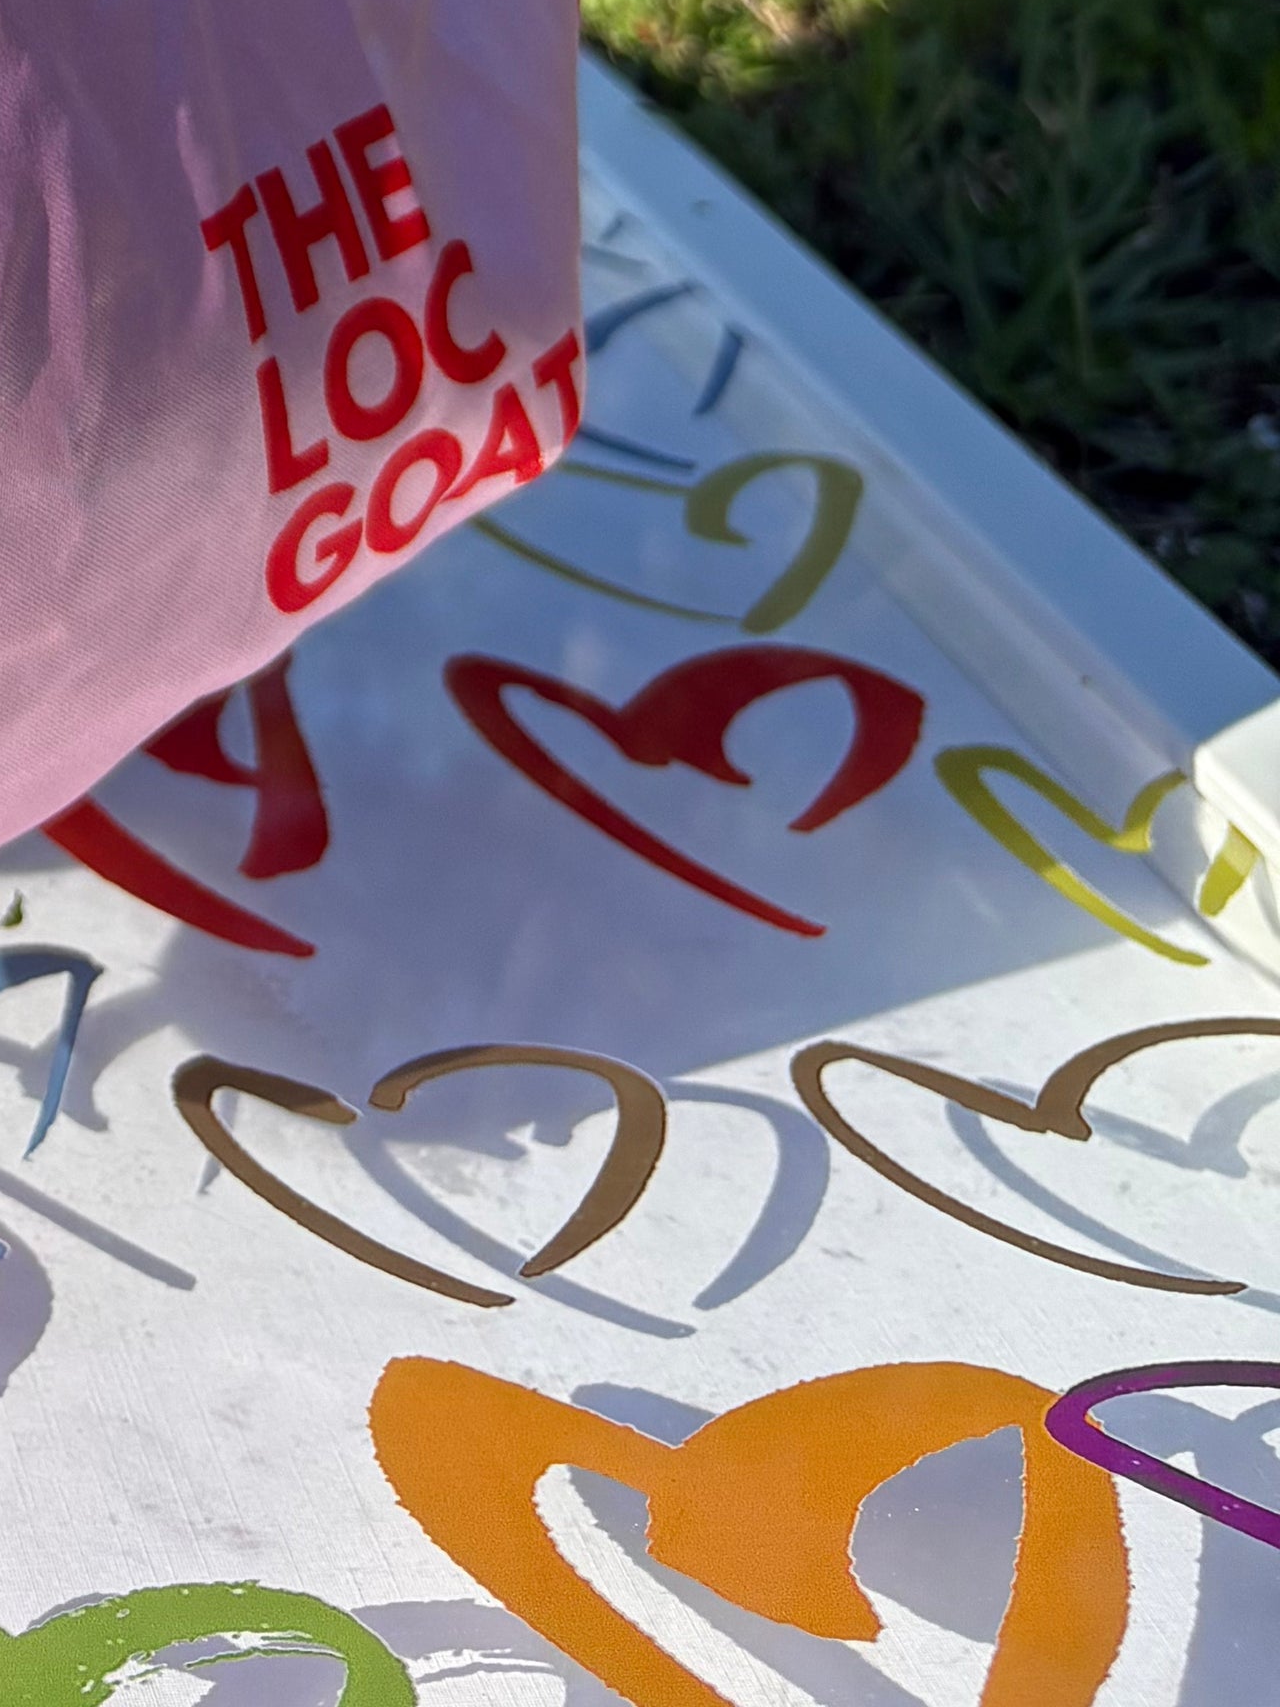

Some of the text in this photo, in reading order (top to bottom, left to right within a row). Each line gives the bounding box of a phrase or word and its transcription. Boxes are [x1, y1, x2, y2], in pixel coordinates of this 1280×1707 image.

[200, 103, 430, 345] THE
[256, 238, 506, 495] LOC
[265, 328, 580, 614] GOAT
